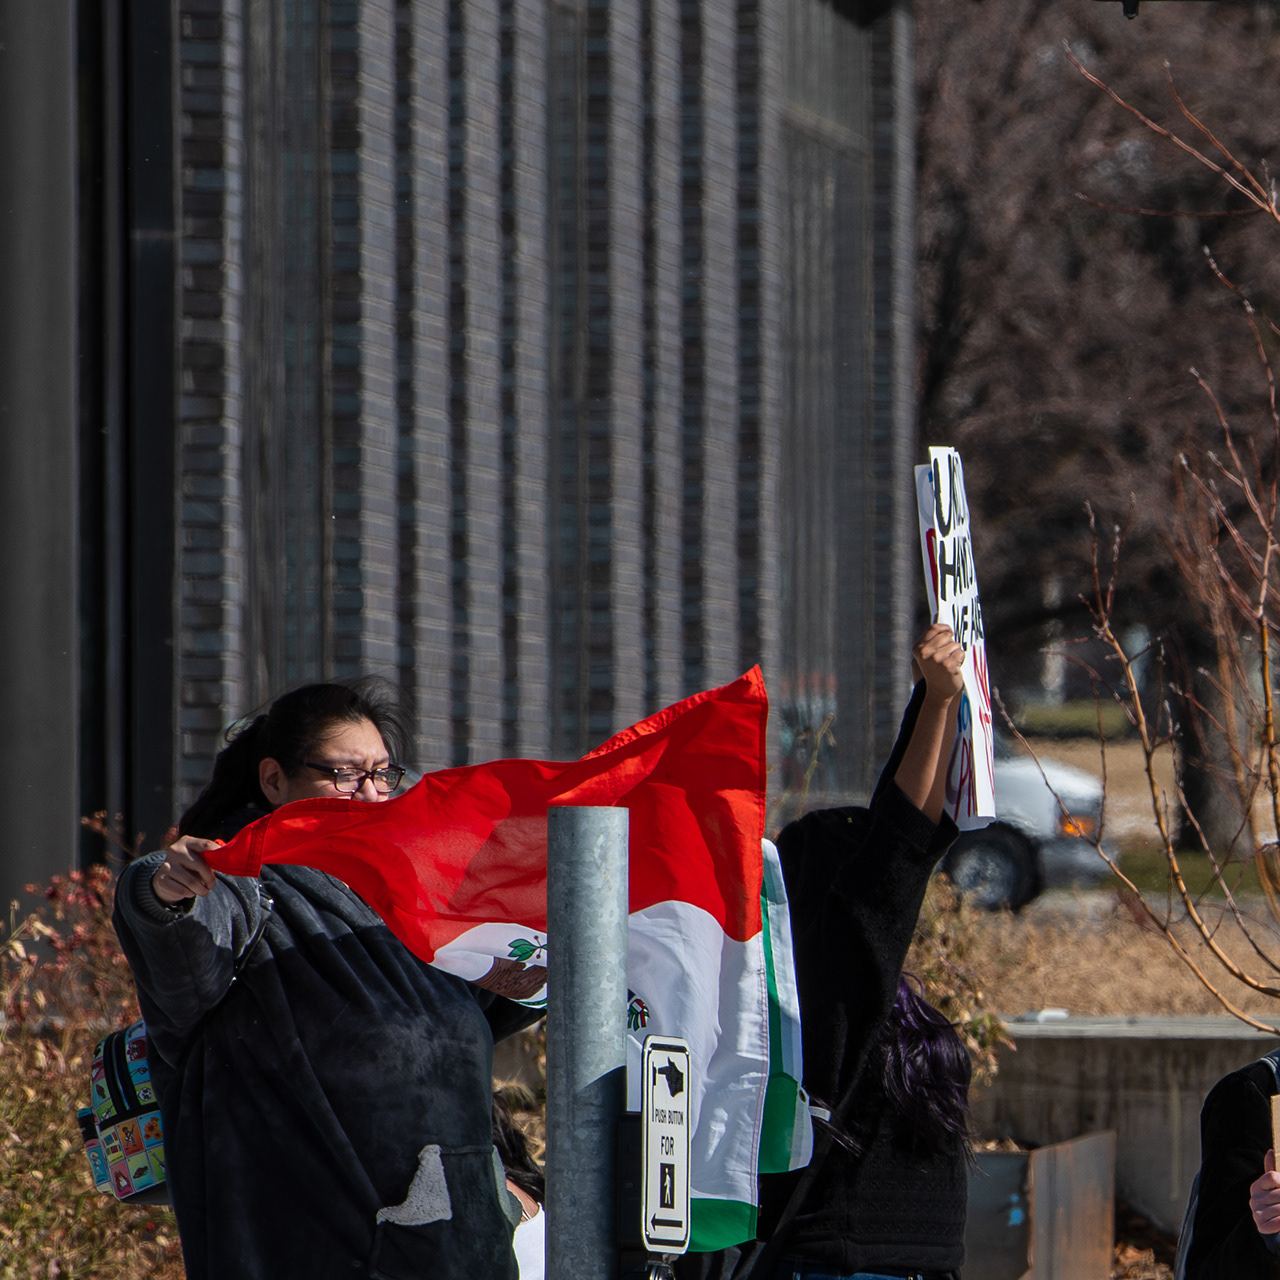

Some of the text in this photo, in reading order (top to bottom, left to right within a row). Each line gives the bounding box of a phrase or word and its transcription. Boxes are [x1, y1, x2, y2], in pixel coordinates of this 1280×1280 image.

[656, 1108, 684, 1125] PUSH BUTTON
[660, 1136, 675, 1156] FOR
